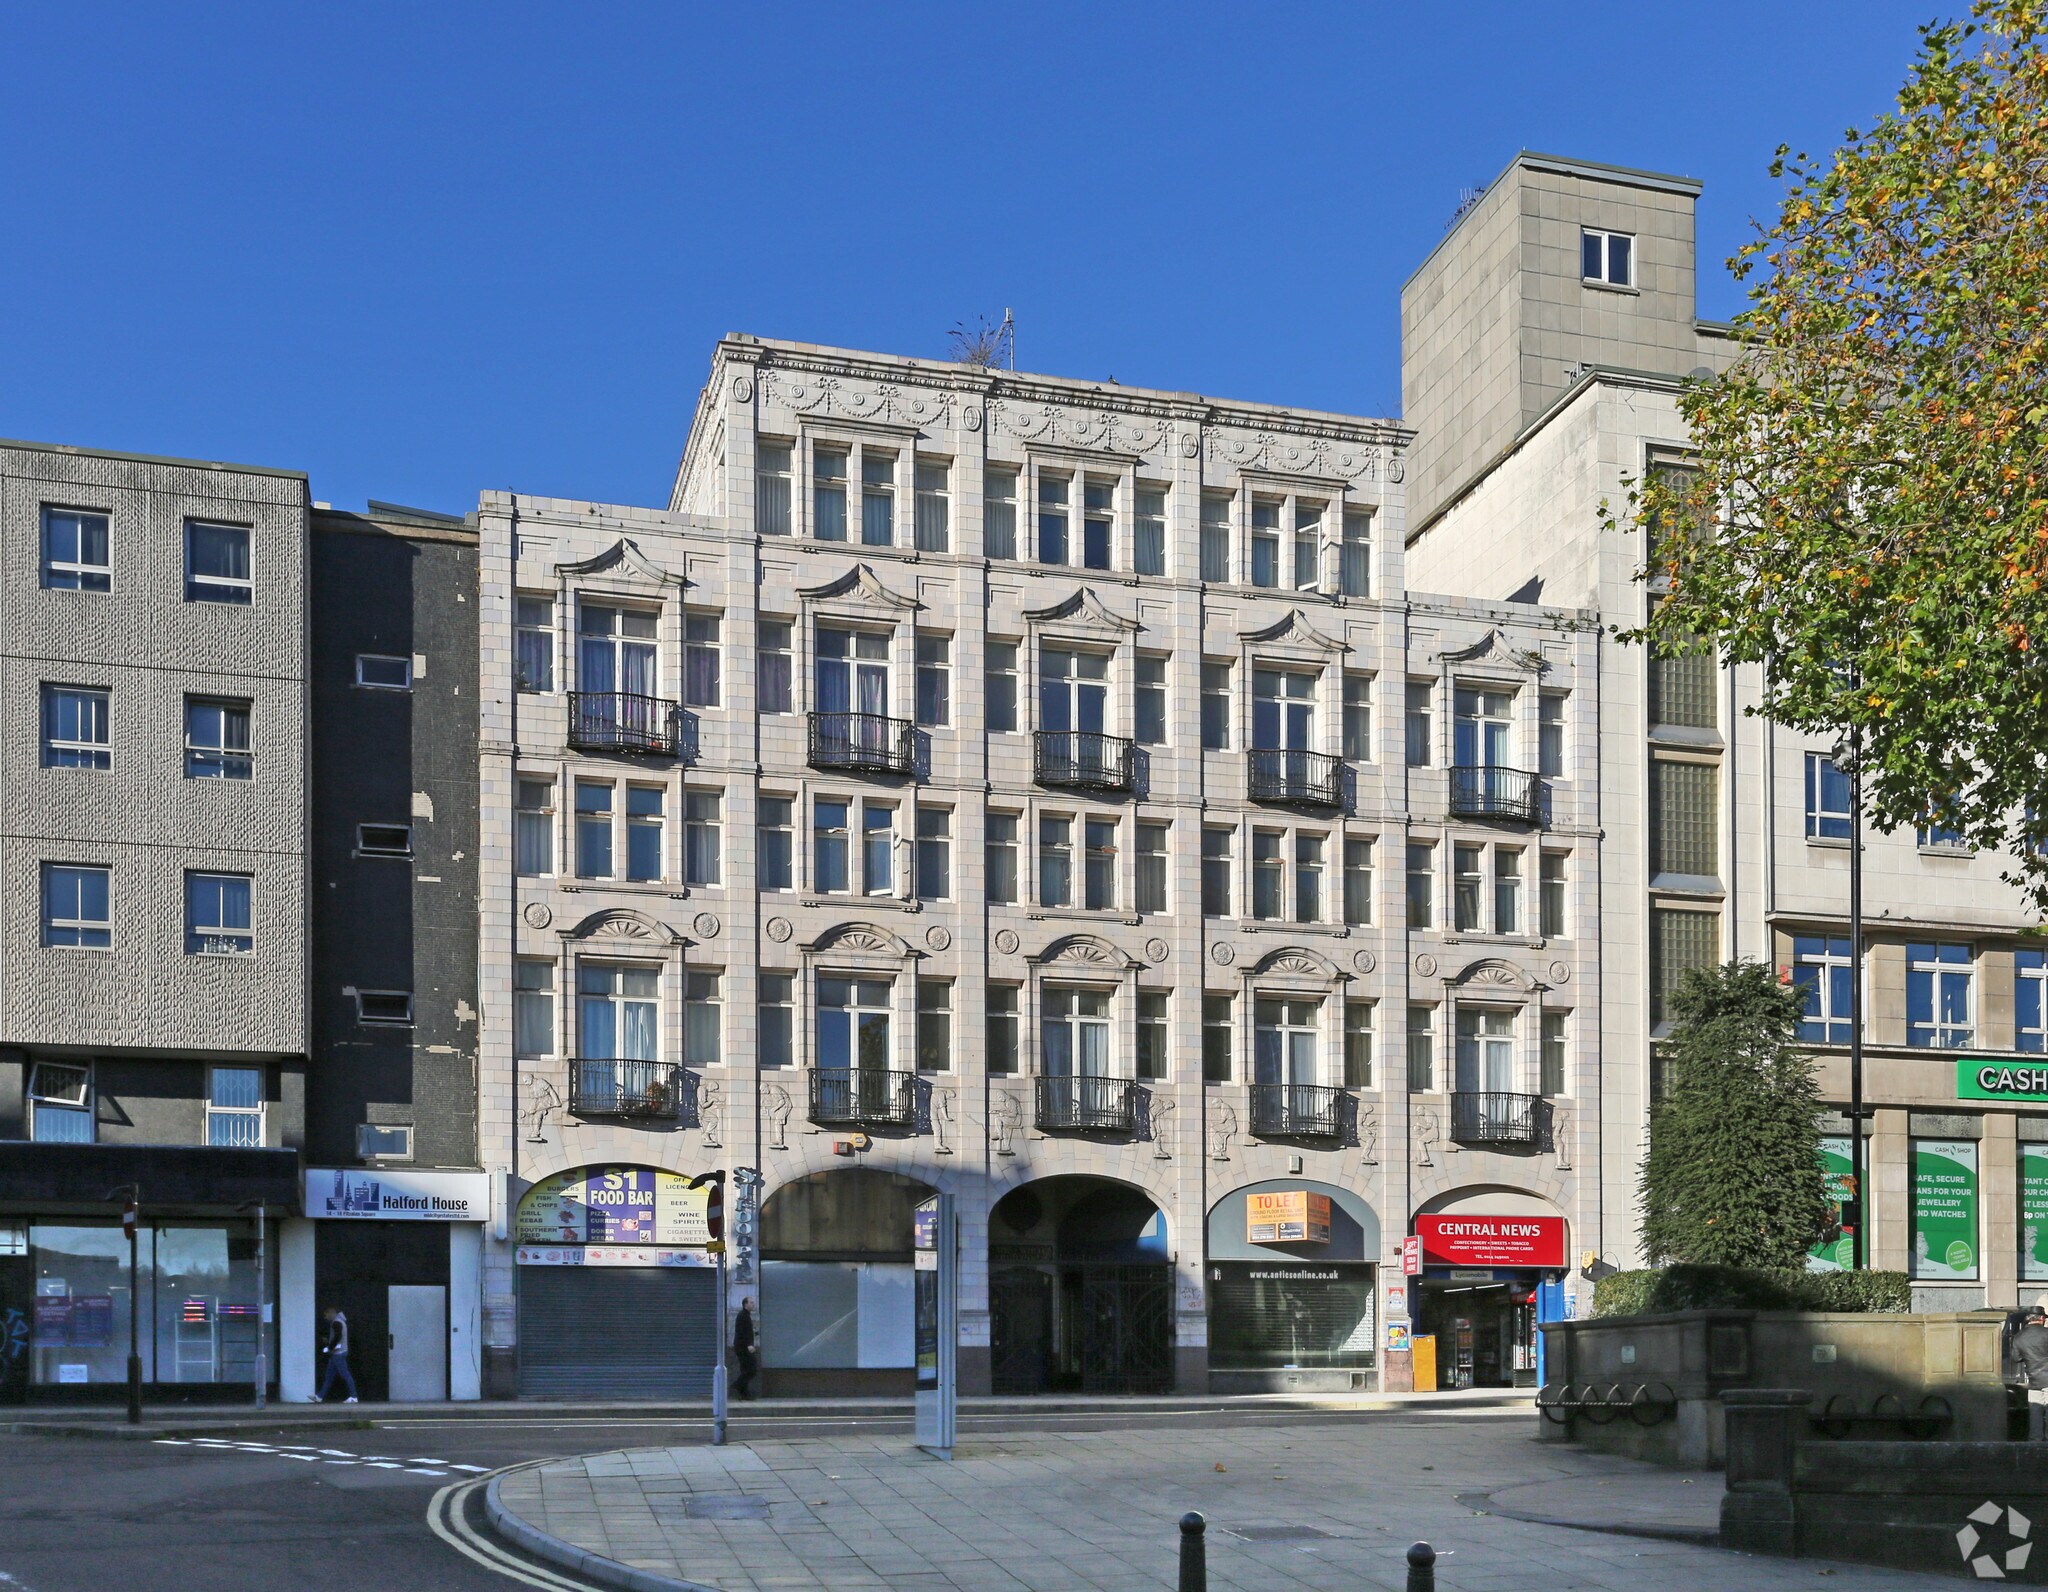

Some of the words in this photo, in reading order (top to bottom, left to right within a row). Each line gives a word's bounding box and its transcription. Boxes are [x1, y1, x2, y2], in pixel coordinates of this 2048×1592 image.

[1977, 1067, 2048, 1095] CASH
[603, 1168, 638, 1190] S1
[1936, 1175, 1965, 1183] SECURE
[590, 1190, 625, 1205] FOOD
[627, 1190, 653, 1205] BAR
[1951, 1188, 1972, 1196] YOUR
[383, 1195, 428, 1210] Halford
[432, 1196, 468, 1210] House
[1257, 1196, 1272, 1208] TO
[1276, 1194, 1298, 1207] LET
[1917, 1199, 1961, 1207] JEWELLERY
[1930, 1210, 1966, 1218] WATCHES
[1438, 1223, 1498, 1236] CENTRAL
[1501, 1224, 1540, 1236] NEWS
[1250, 1270, 1338, 1280] www.anticsonline.co.uk
